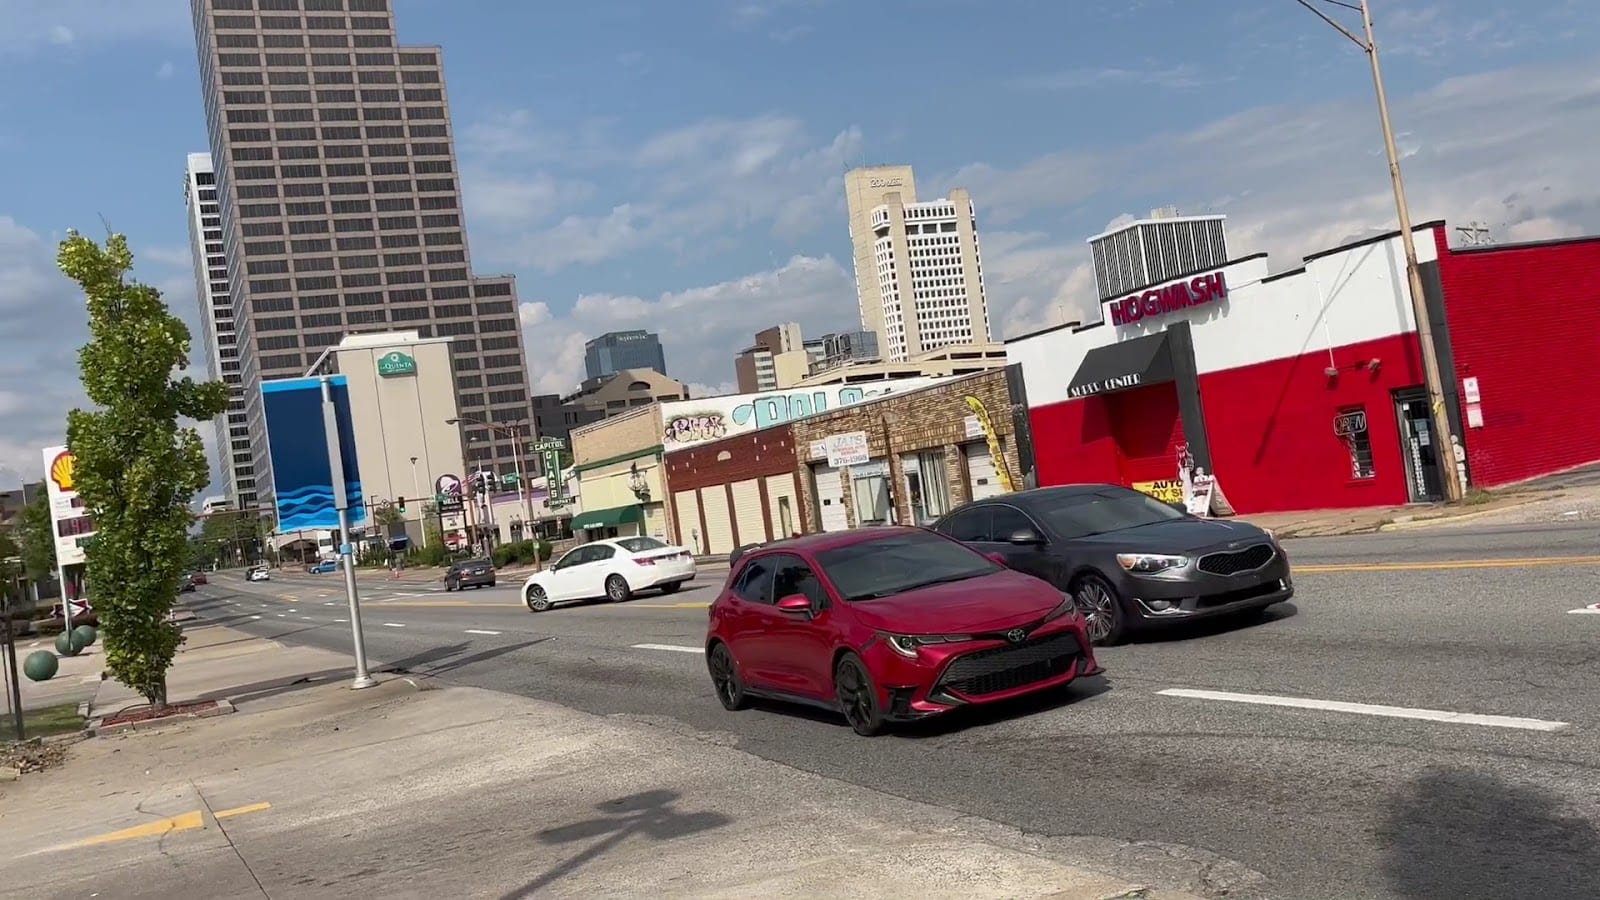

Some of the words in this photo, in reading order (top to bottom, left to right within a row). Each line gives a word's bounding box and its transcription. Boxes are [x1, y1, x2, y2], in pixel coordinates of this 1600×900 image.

[1110, 271, 1226, 326] HOGWASH
[1104, 373, 1141, 390] CENTER
[1335, 414, 1364, 433] OPEN
[534, 441, 565, 451] CAPITOL
[546, 451, 558, 498] GLASS
[1153, 480, 1183, 490] AUTO
